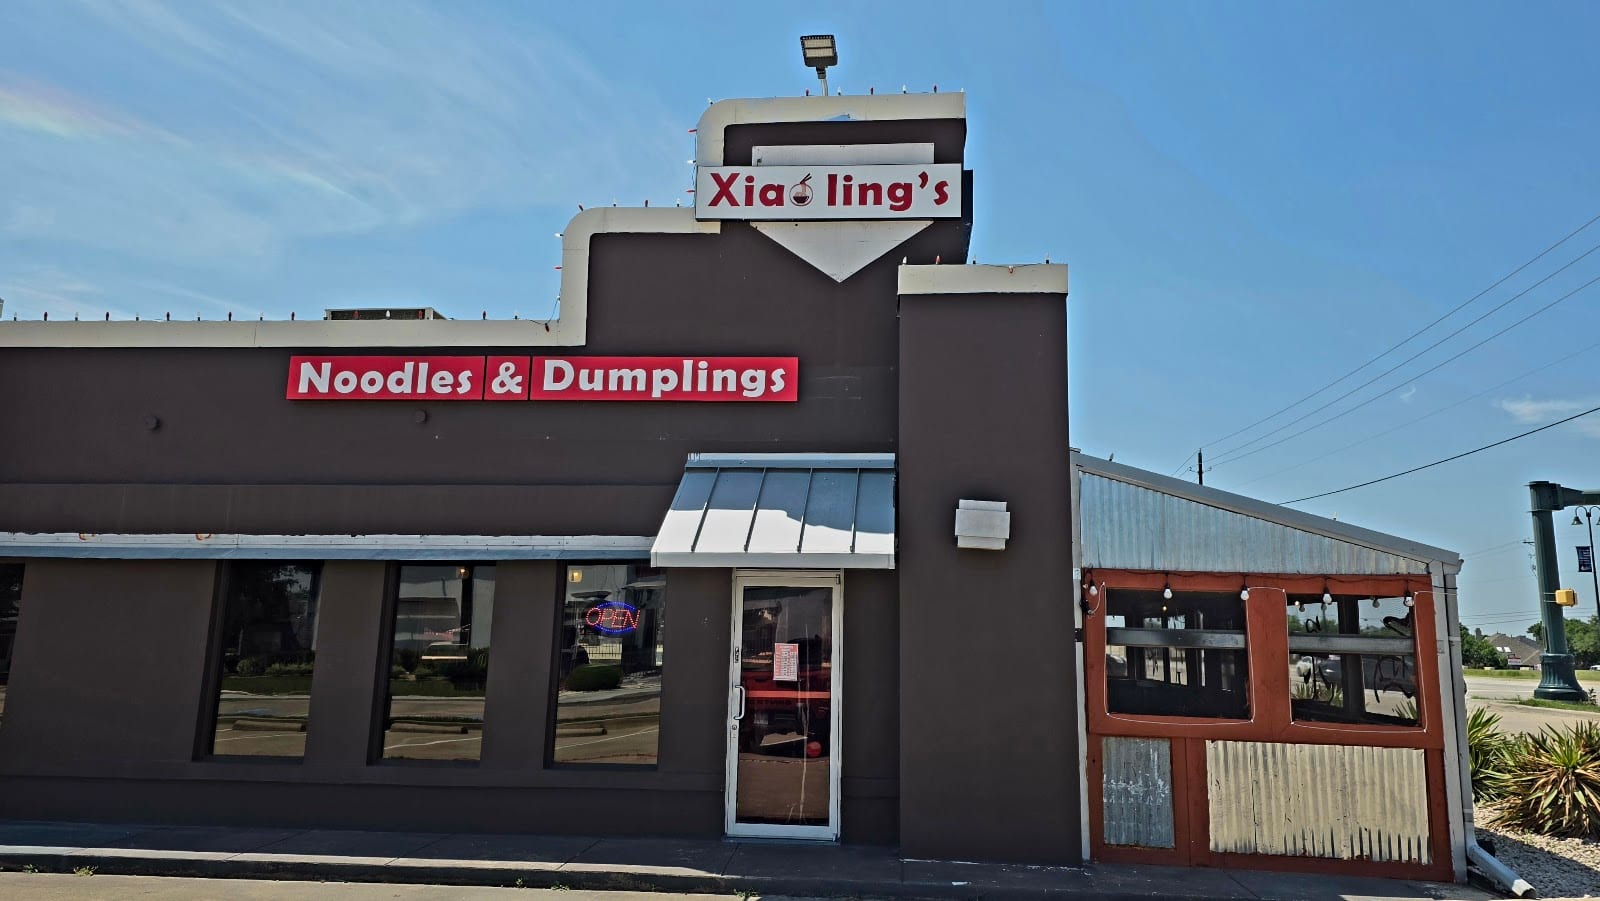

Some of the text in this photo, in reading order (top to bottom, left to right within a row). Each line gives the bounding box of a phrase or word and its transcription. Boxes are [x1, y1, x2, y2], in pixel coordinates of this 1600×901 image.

[297, 359, 787, 398] Noodles & Dumplings
[585, 607, 641, 629] OPEN
